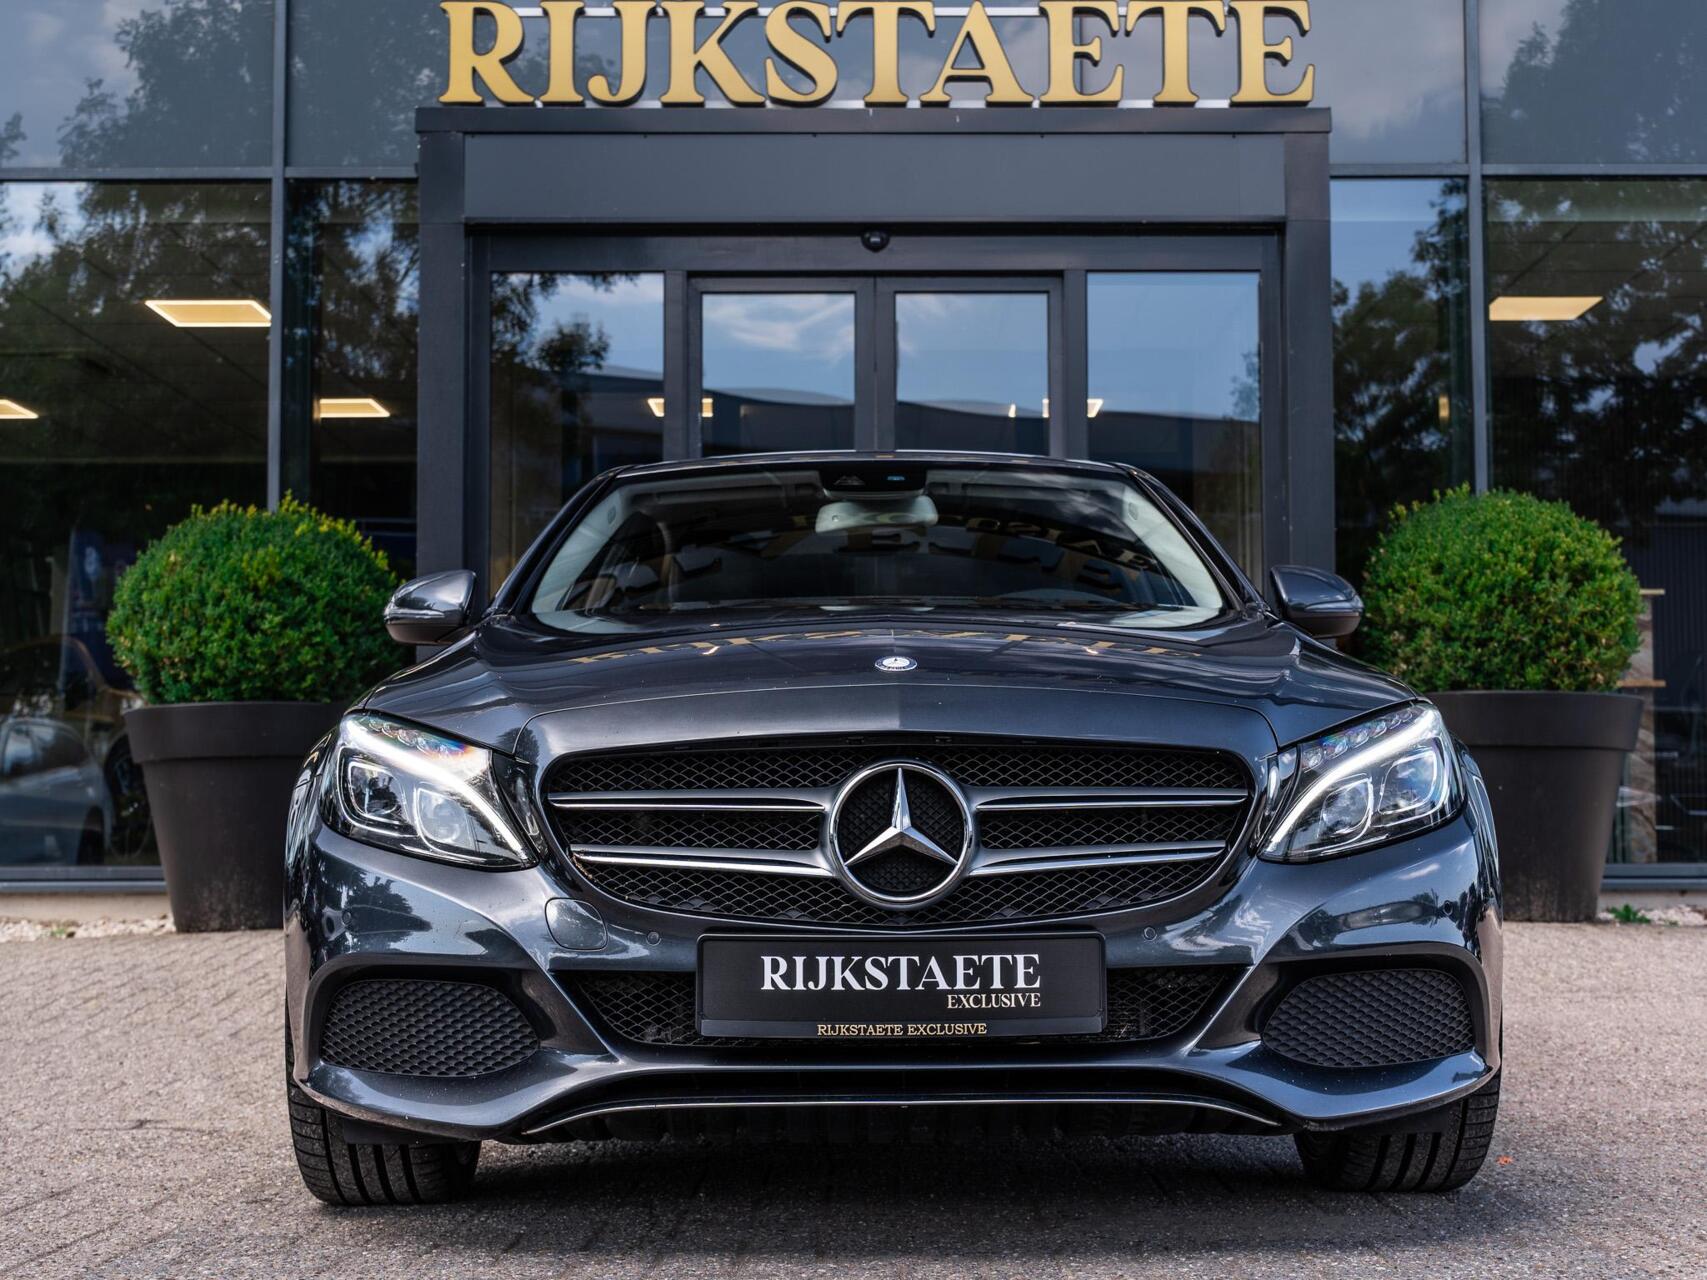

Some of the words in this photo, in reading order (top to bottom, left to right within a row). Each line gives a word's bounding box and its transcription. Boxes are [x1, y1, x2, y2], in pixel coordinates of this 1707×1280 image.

[440, 0, 1316, 107] RIJKSTAETE
[761, 954, 1041, 991] RIJKSTAETE
[947, 993, 1041, 1009] EXCLUSIVE
[817, 1024, 904, 1036] RIJKSTAETE
[908, 1023, 988, 1036] EXCLUSIVE
